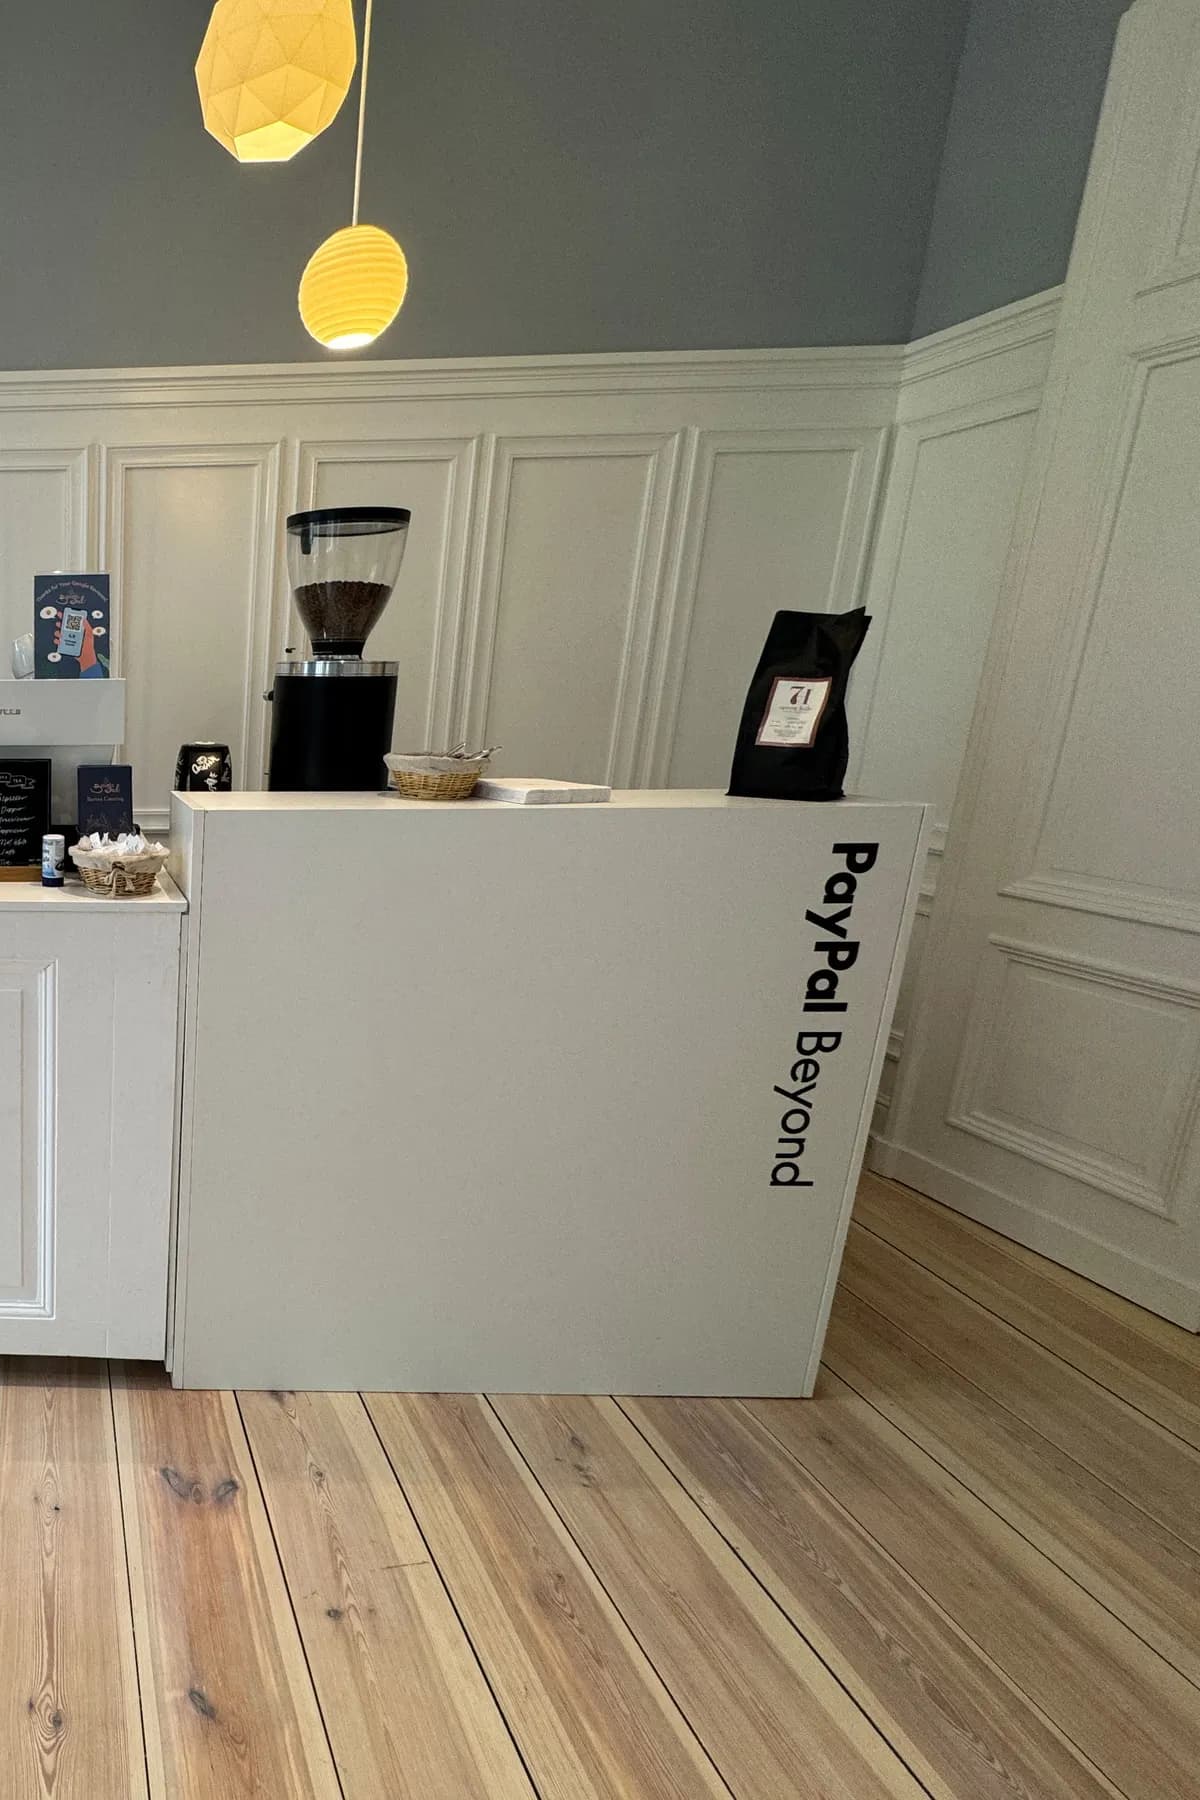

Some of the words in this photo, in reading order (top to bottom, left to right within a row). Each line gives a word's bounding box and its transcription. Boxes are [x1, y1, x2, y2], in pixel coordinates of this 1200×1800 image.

[790, 686, 811, 705] 71
[803, 843, 879, 1012] PayPal
[770, 1032, 842, 1187] Beyond
